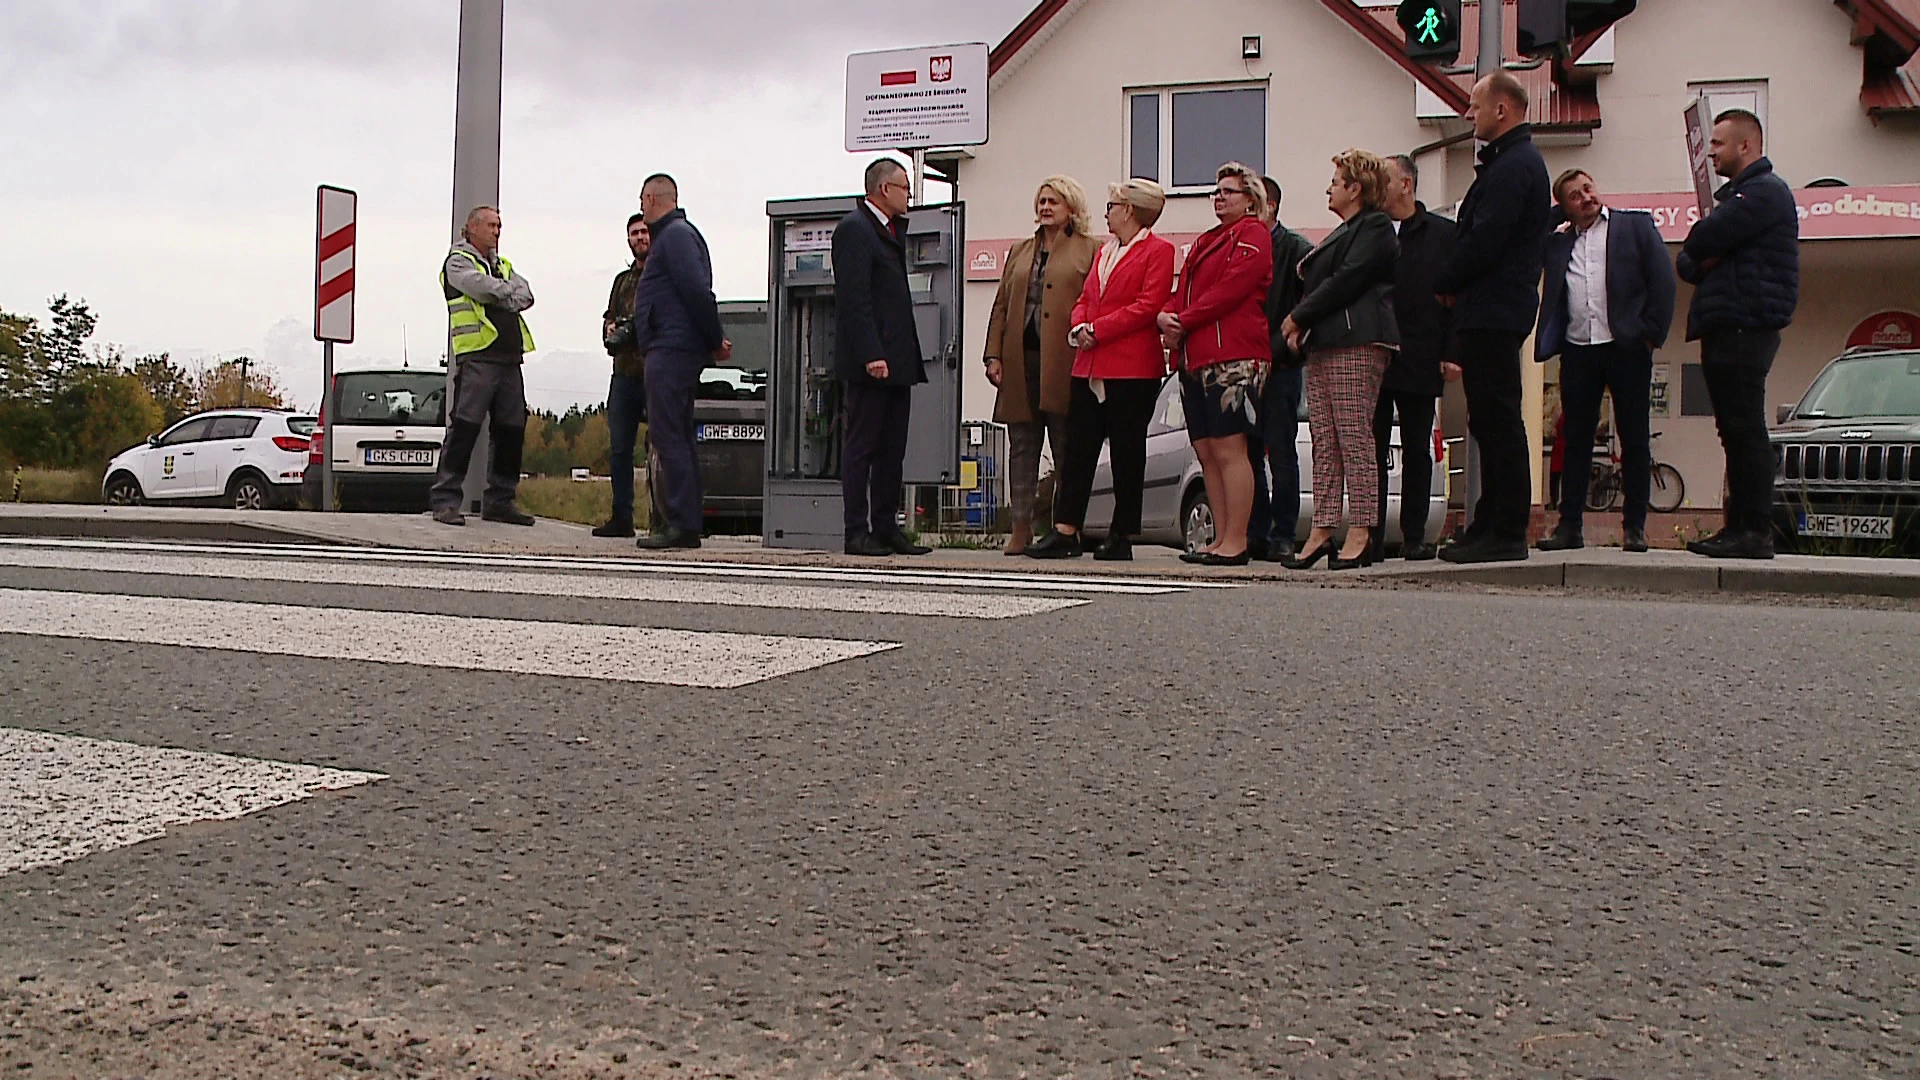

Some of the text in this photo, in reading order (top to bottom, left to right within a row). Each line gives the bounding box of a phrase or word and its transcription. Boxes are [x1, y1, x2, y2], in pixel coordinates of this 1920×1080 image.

[1811, 202, 1833, 216] co
[1835, 194, 1909, 217] dobre
[705, 426, 766, 438] GWE 8899
[1841, 429, 1872, 438] Jeep
[374, 450, 430, 462] GKS CF03
[1806, 516, 1889, 534] GWE 1962K
